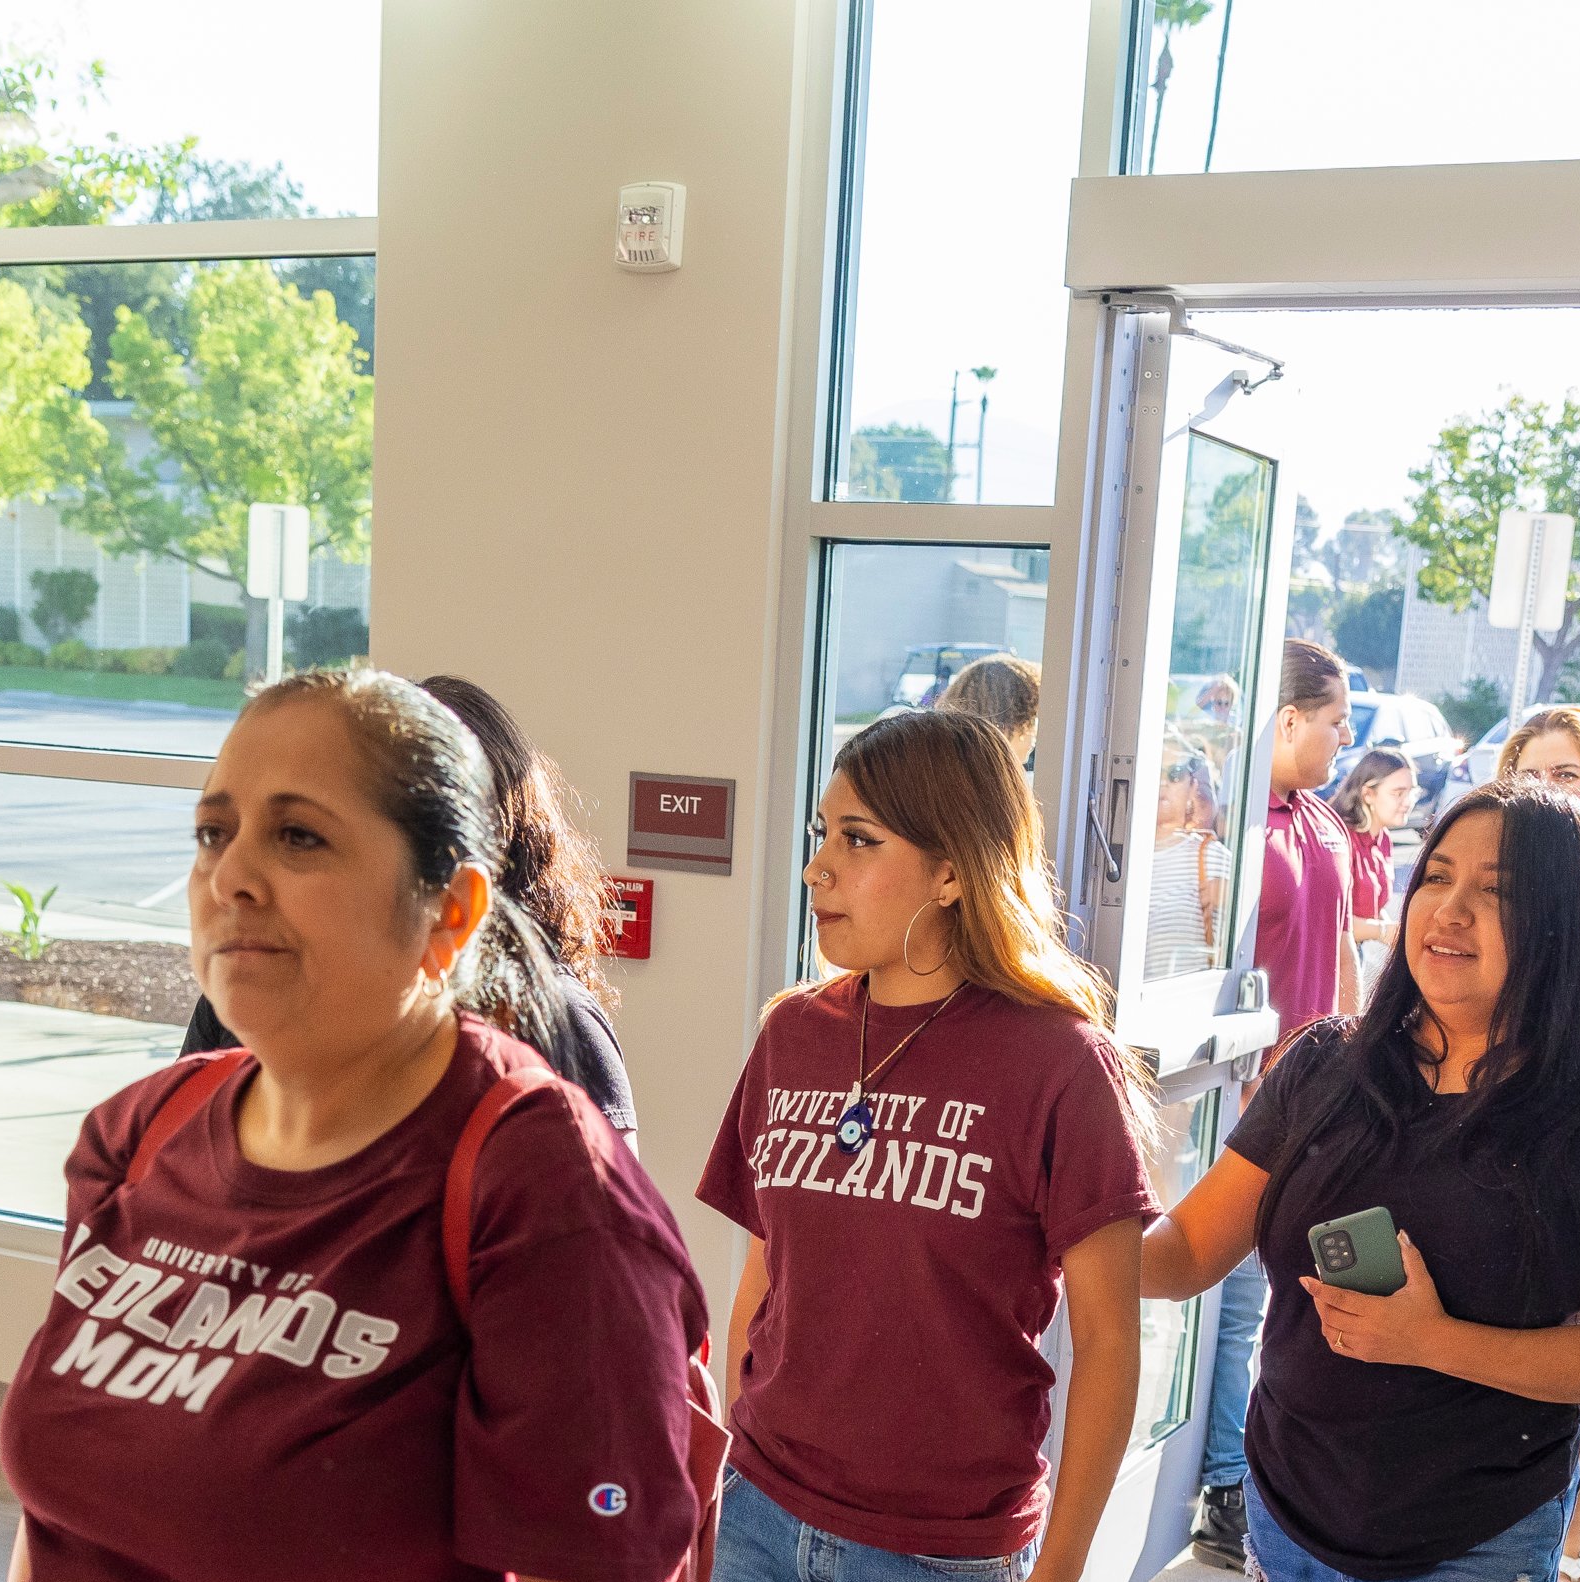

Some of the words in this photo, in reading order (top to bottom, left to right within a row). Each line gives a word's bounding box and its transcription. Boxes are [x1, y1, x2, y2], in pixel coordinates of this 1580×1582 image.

[625, 230, 655, 242] FIRE
[660, 793, 702, 815] EXIT
[936, 1100, 986, 1142] OF
[141, 1236, 271, 1288] UNIVERITY
[276, 1271, 314, 1293] OF
[51, 1318, 234, 1414] MOM
